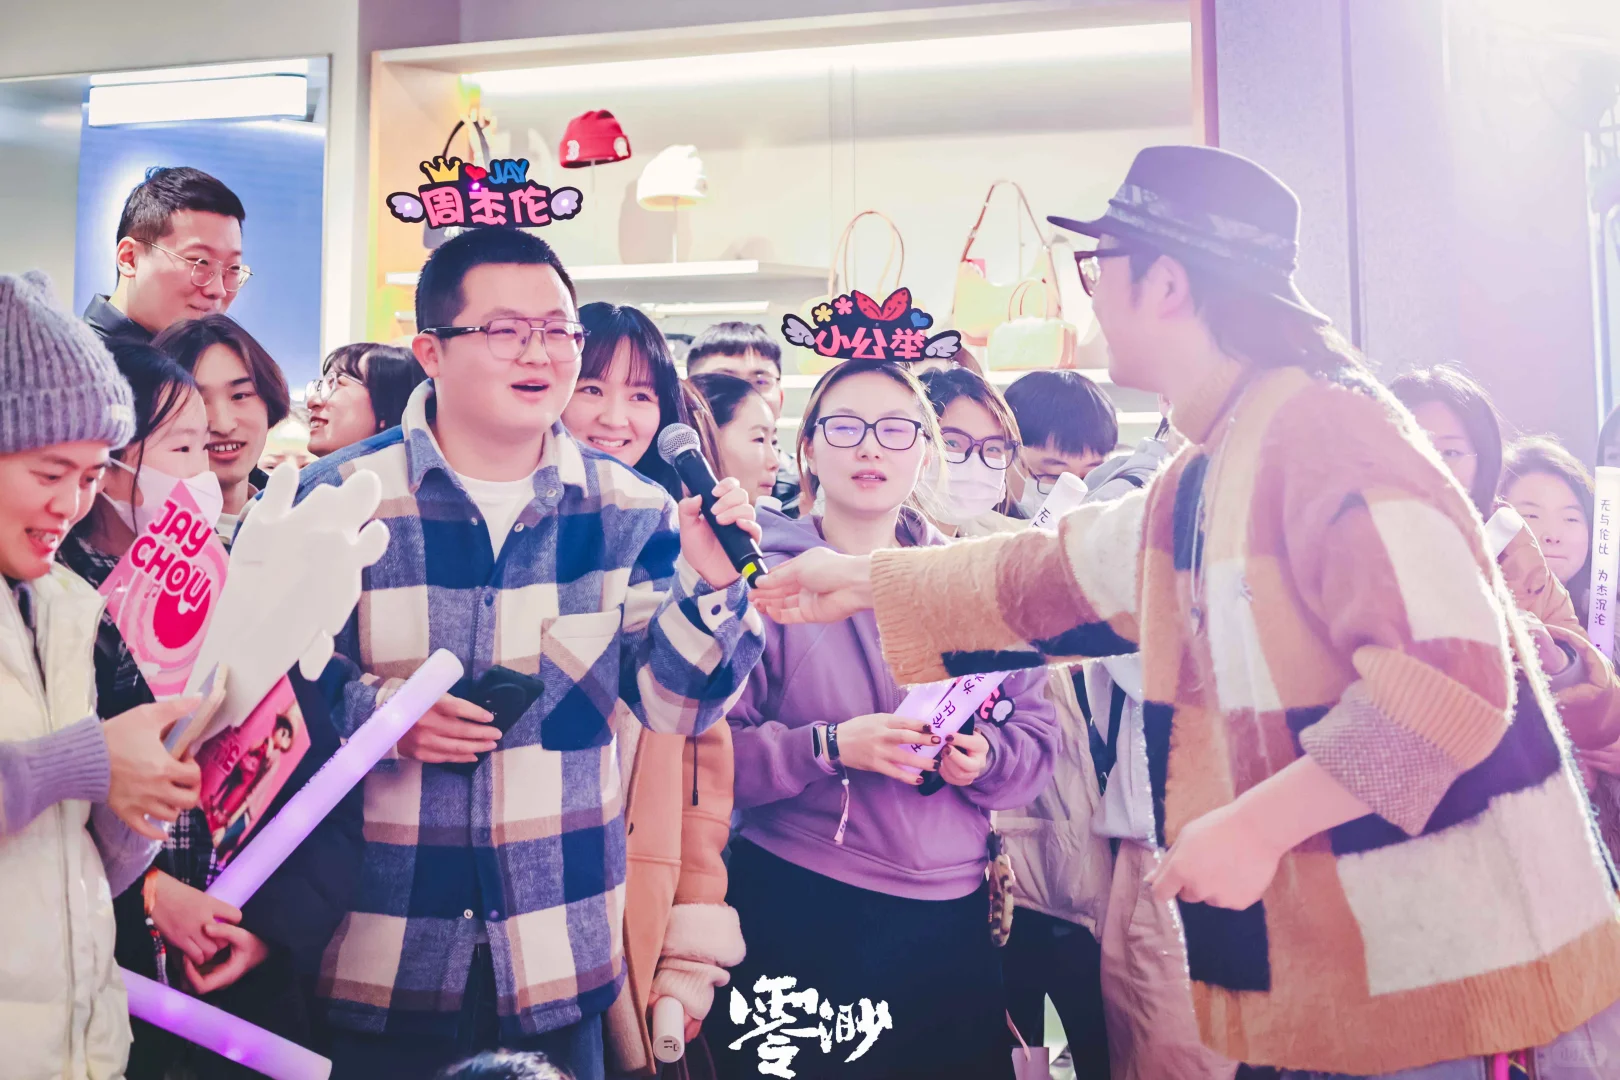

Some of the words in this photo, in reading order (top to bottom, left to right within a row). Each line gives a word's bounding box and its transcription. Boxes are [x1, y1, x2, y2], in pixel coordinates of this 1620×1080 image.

[488, 158, 529, 185] JAY
[419, 185, 550, 227] 周杰伦
[814, 324, 926, 360] 小公举
[147, 499, 213, 559] JAY
[1598, 499, 1611, 556] 无与伦比
[130, 535, 212, 608] CHOU
[1594, 568, 1609, 627] 为杰沉沦
